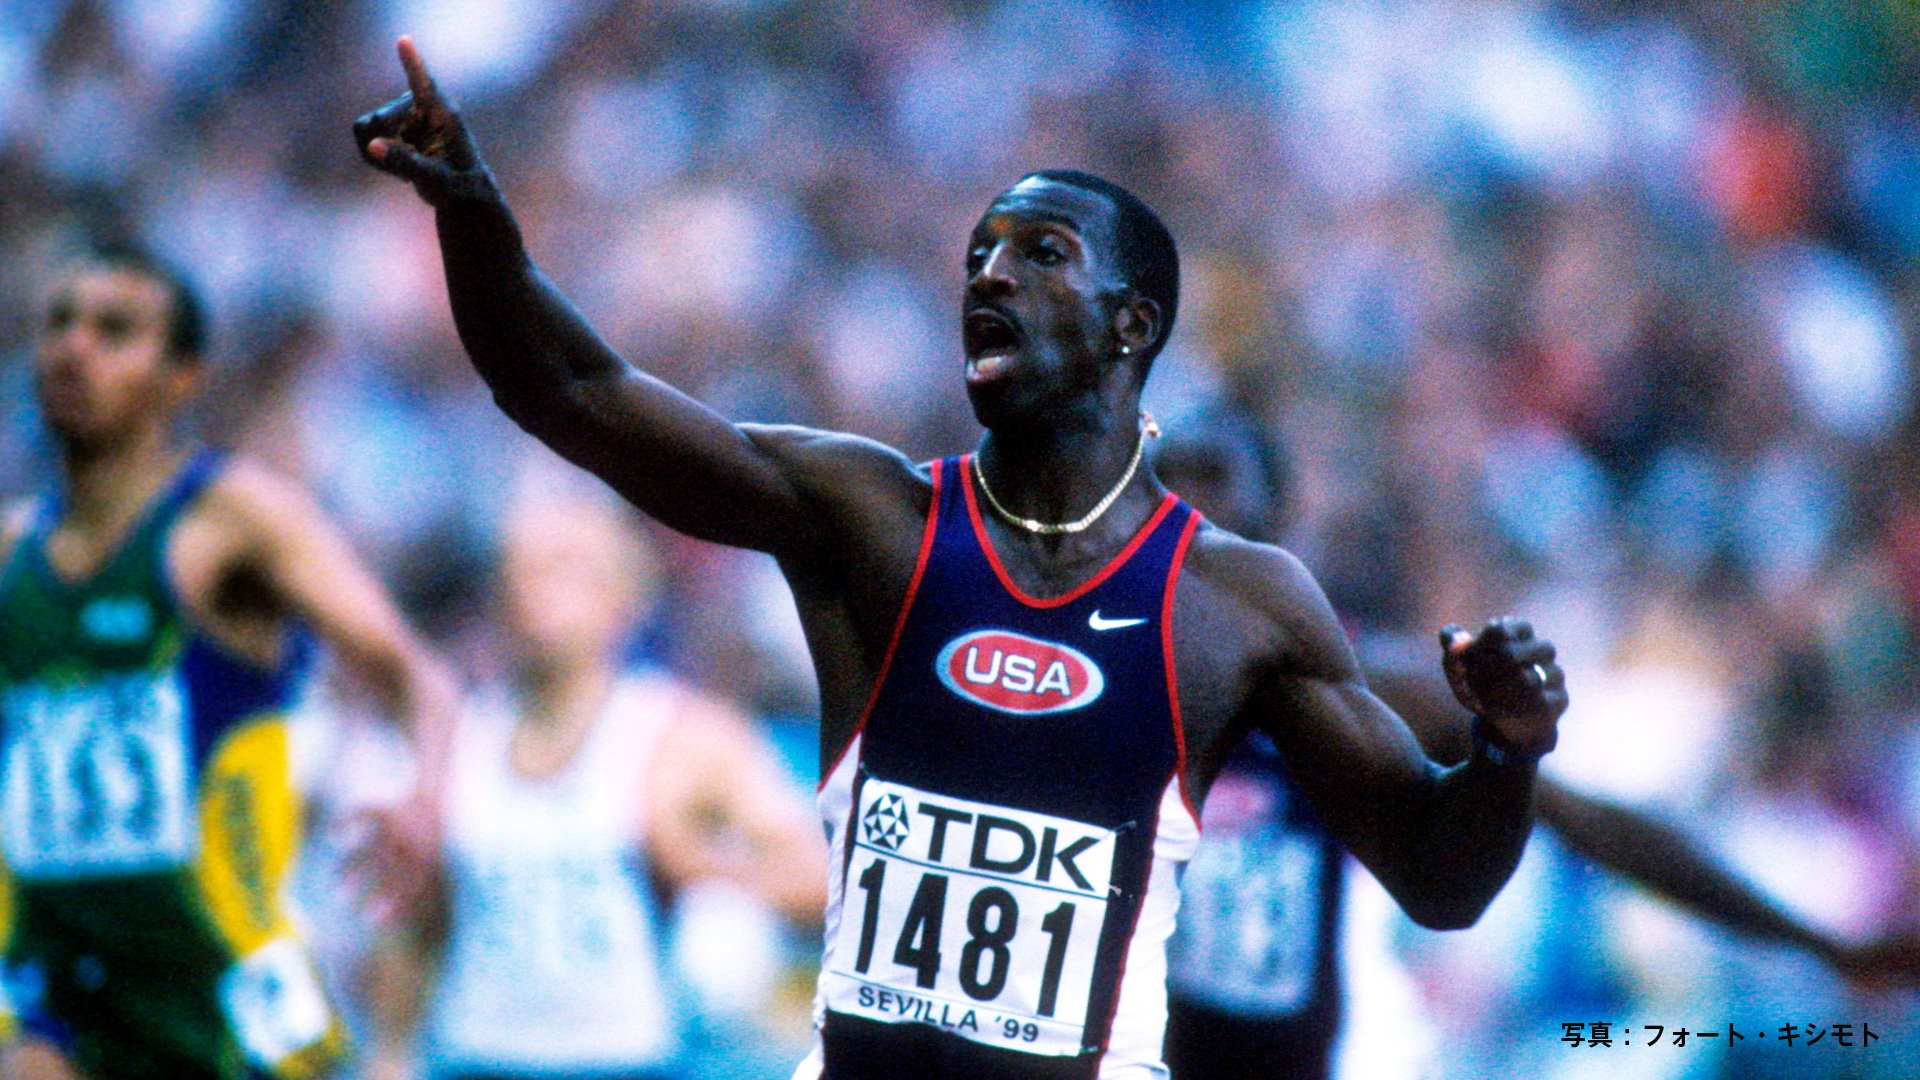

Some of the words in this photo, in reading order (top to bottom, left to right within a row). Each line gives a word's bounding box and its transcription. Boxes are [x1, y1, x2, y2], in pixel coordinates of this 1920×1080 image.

[965, 646, 1071, 697] USA
[918, 802, 1100, 892] TDK
[855, 858, 1077, 1018] 1481
[858, 986, 979, 1033] SEVILLA
[995, 1015, 1039, 1043] '99
